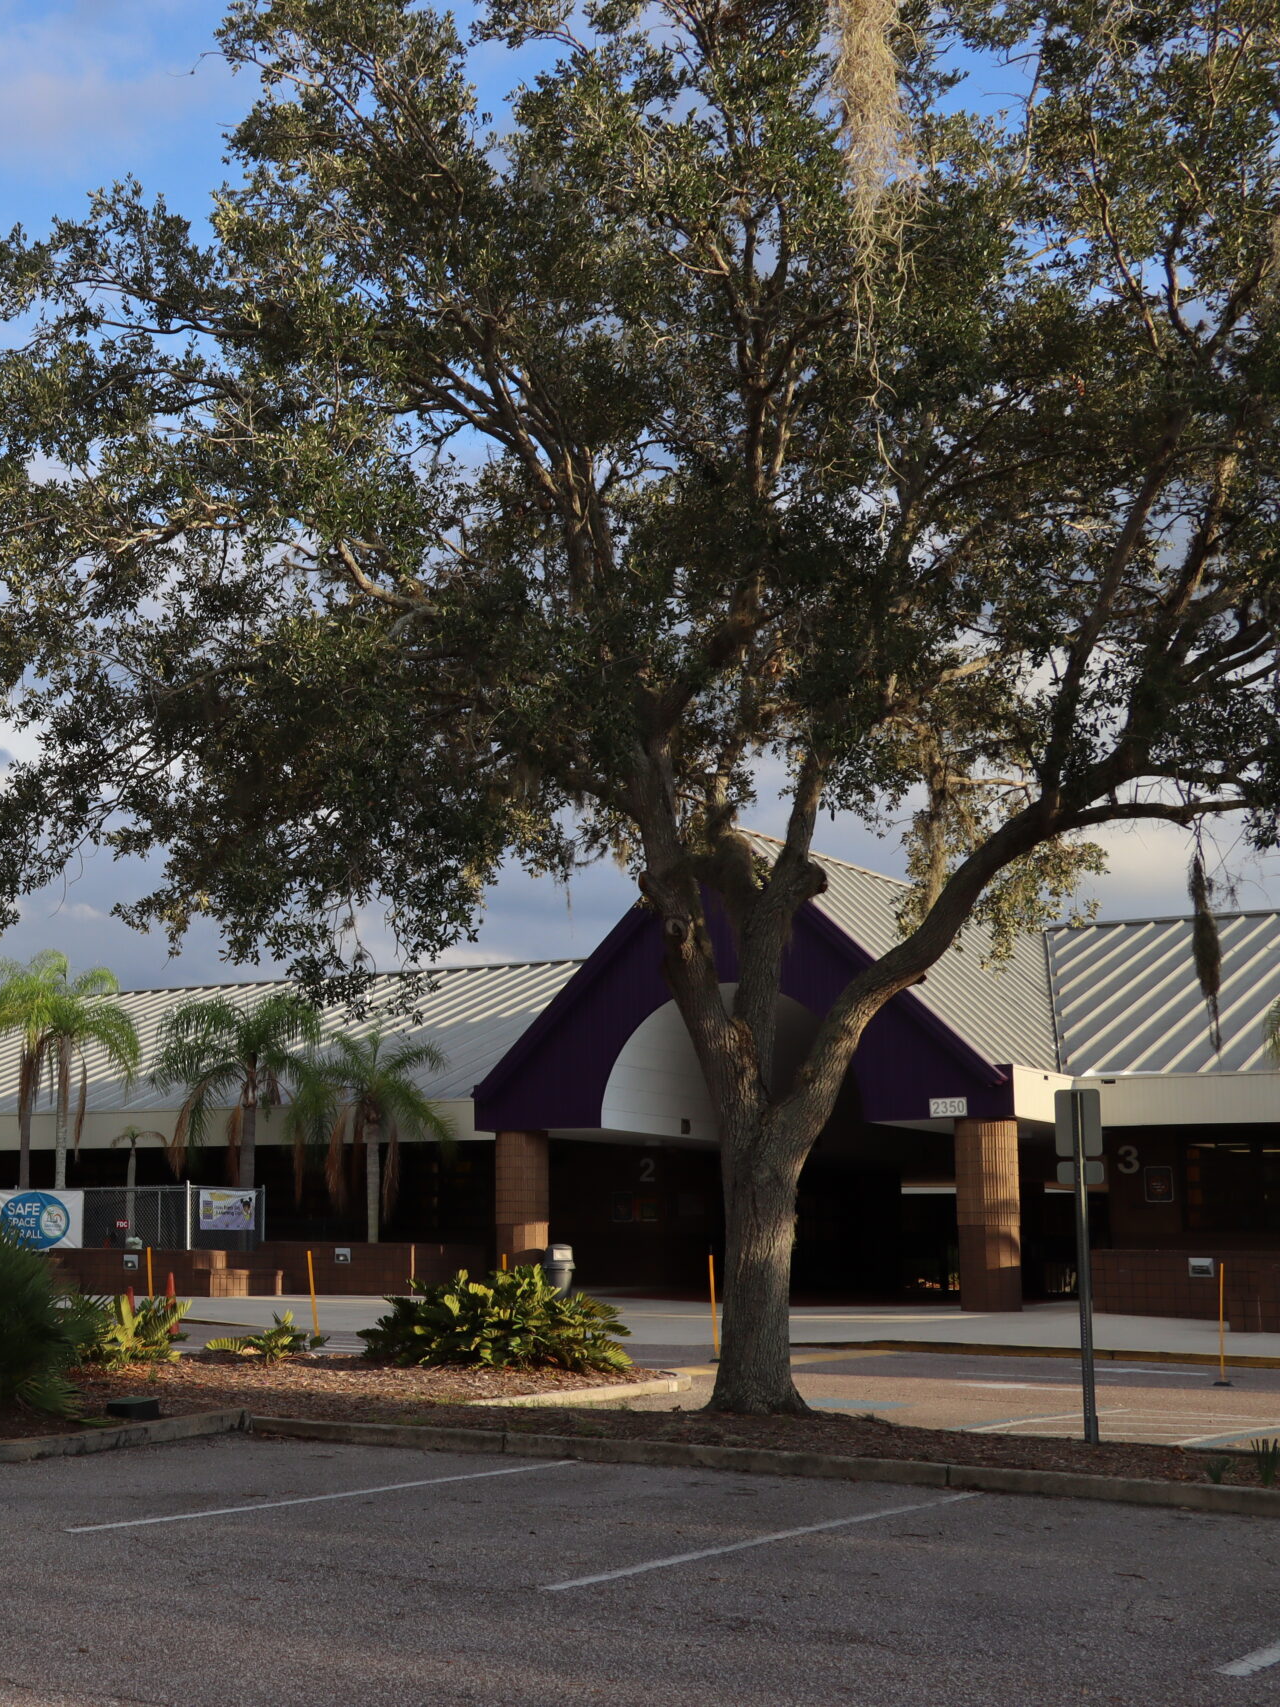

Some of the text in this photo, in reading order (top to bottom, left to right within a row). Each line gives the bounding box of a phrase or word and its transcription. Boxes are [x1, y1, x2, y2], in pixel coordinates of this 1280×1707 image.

[932, 1100, 965, 1114] 2350
[1118, 1145, 1140, 1174] 3
[639, 1158, 655, 1182] 2
[7, 1202, 41, 1216] SAFE
[116, 1220, 128, 1228] FDC
[26, 1229, 43, 1239] ALL
